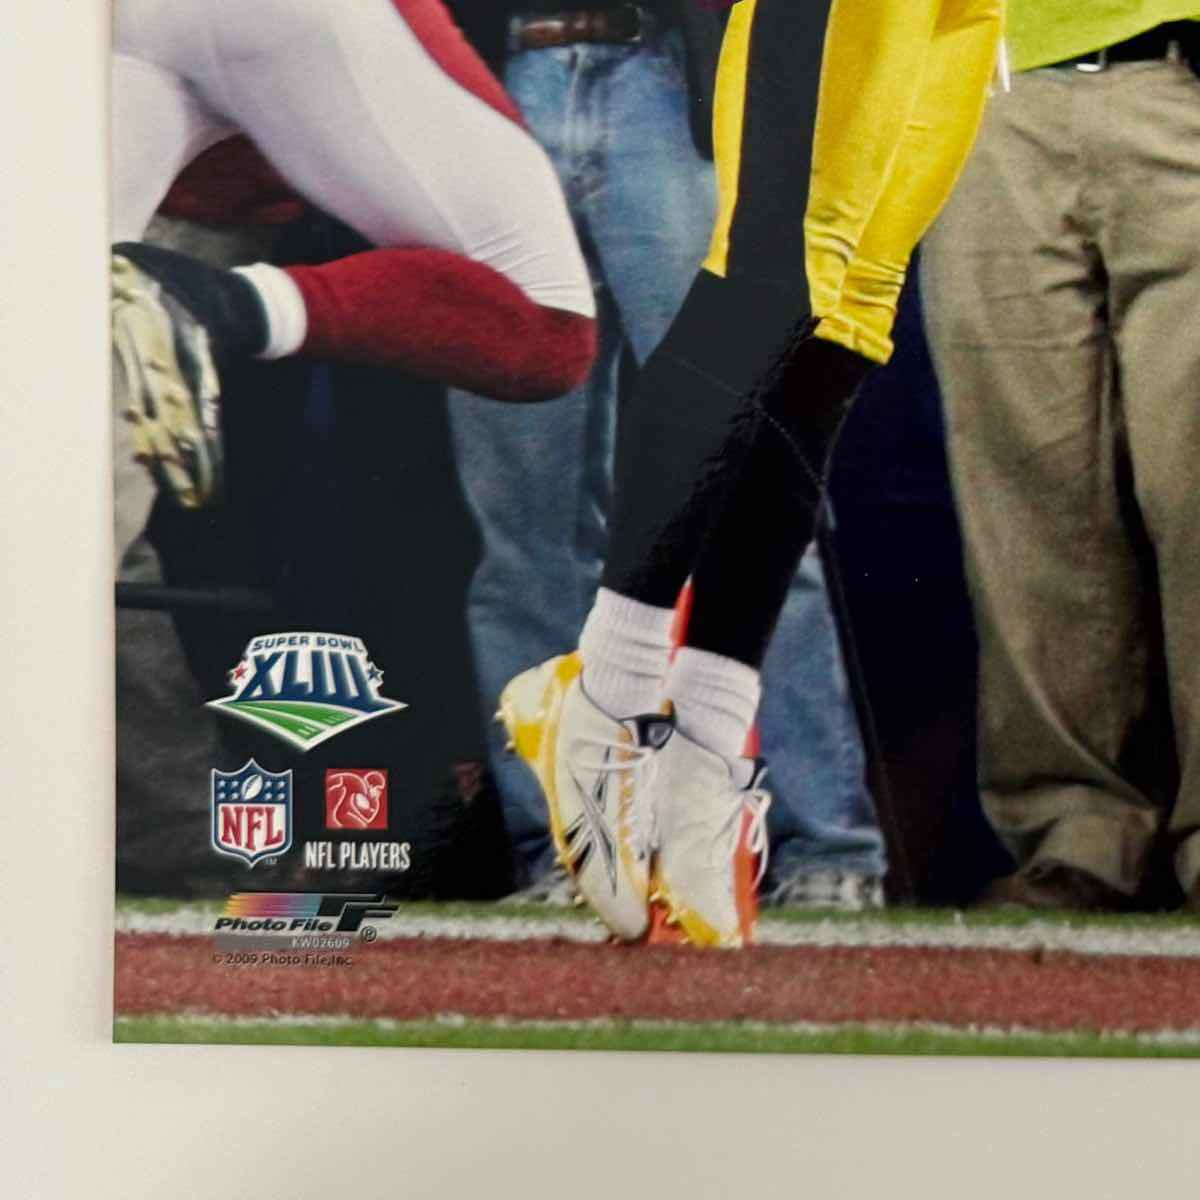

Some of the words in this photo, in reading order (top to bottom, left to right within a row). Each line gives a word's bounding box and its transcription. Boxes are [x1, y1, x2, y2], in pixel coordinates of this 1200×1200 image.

[253, 635, 309, 650] SUPER
[317, 635, 363, 650] BOWL
[236, 650, 373, 702] XLIII
[220, 805, 284, 851] NFL
[305, 841, 336, 869] NFL
[340, 841, 411, 870] PLAYERS
[214, 917, 287, 932] Photo
[289, 917, 333, 932] File
[226, 953, 257, 965] 2009
[261, 953, 300, 965] Photo
